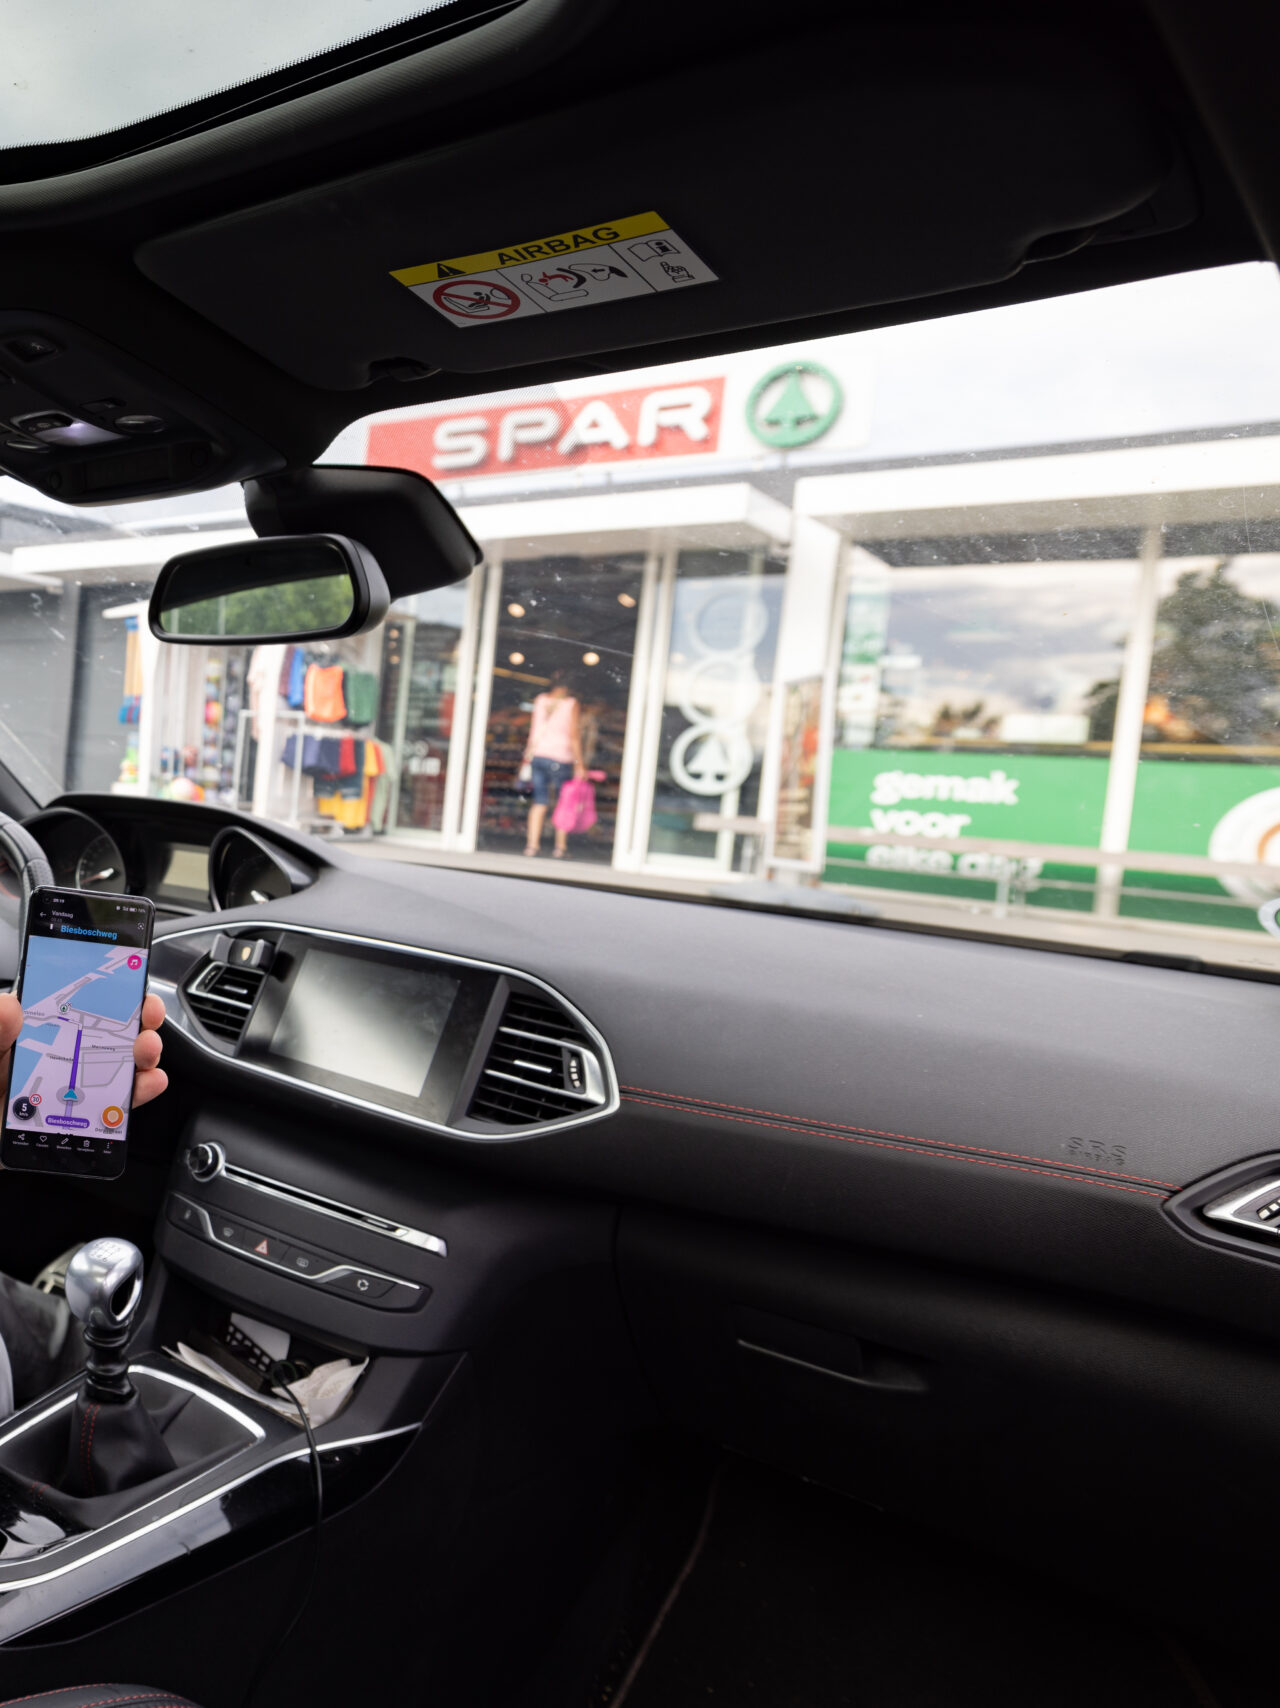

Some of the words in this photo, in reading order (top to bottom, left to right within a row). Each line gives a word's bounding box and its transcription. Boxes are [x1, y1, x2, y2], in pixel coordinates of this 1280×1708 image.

[497, 226, 620, 266] AIRBAG
[431, 385, 714, 471] SPAR
[870, 769, 1019, 806] gemak
[870, 808, 972, 839] voor
[60, 924, 118, 940] Biesboschweg
[21, 1103, 28, 1112] 5
[47, 1117, 88, 1128] Biesboschweg
[1067, 1136, 1127, 1158] SRS
